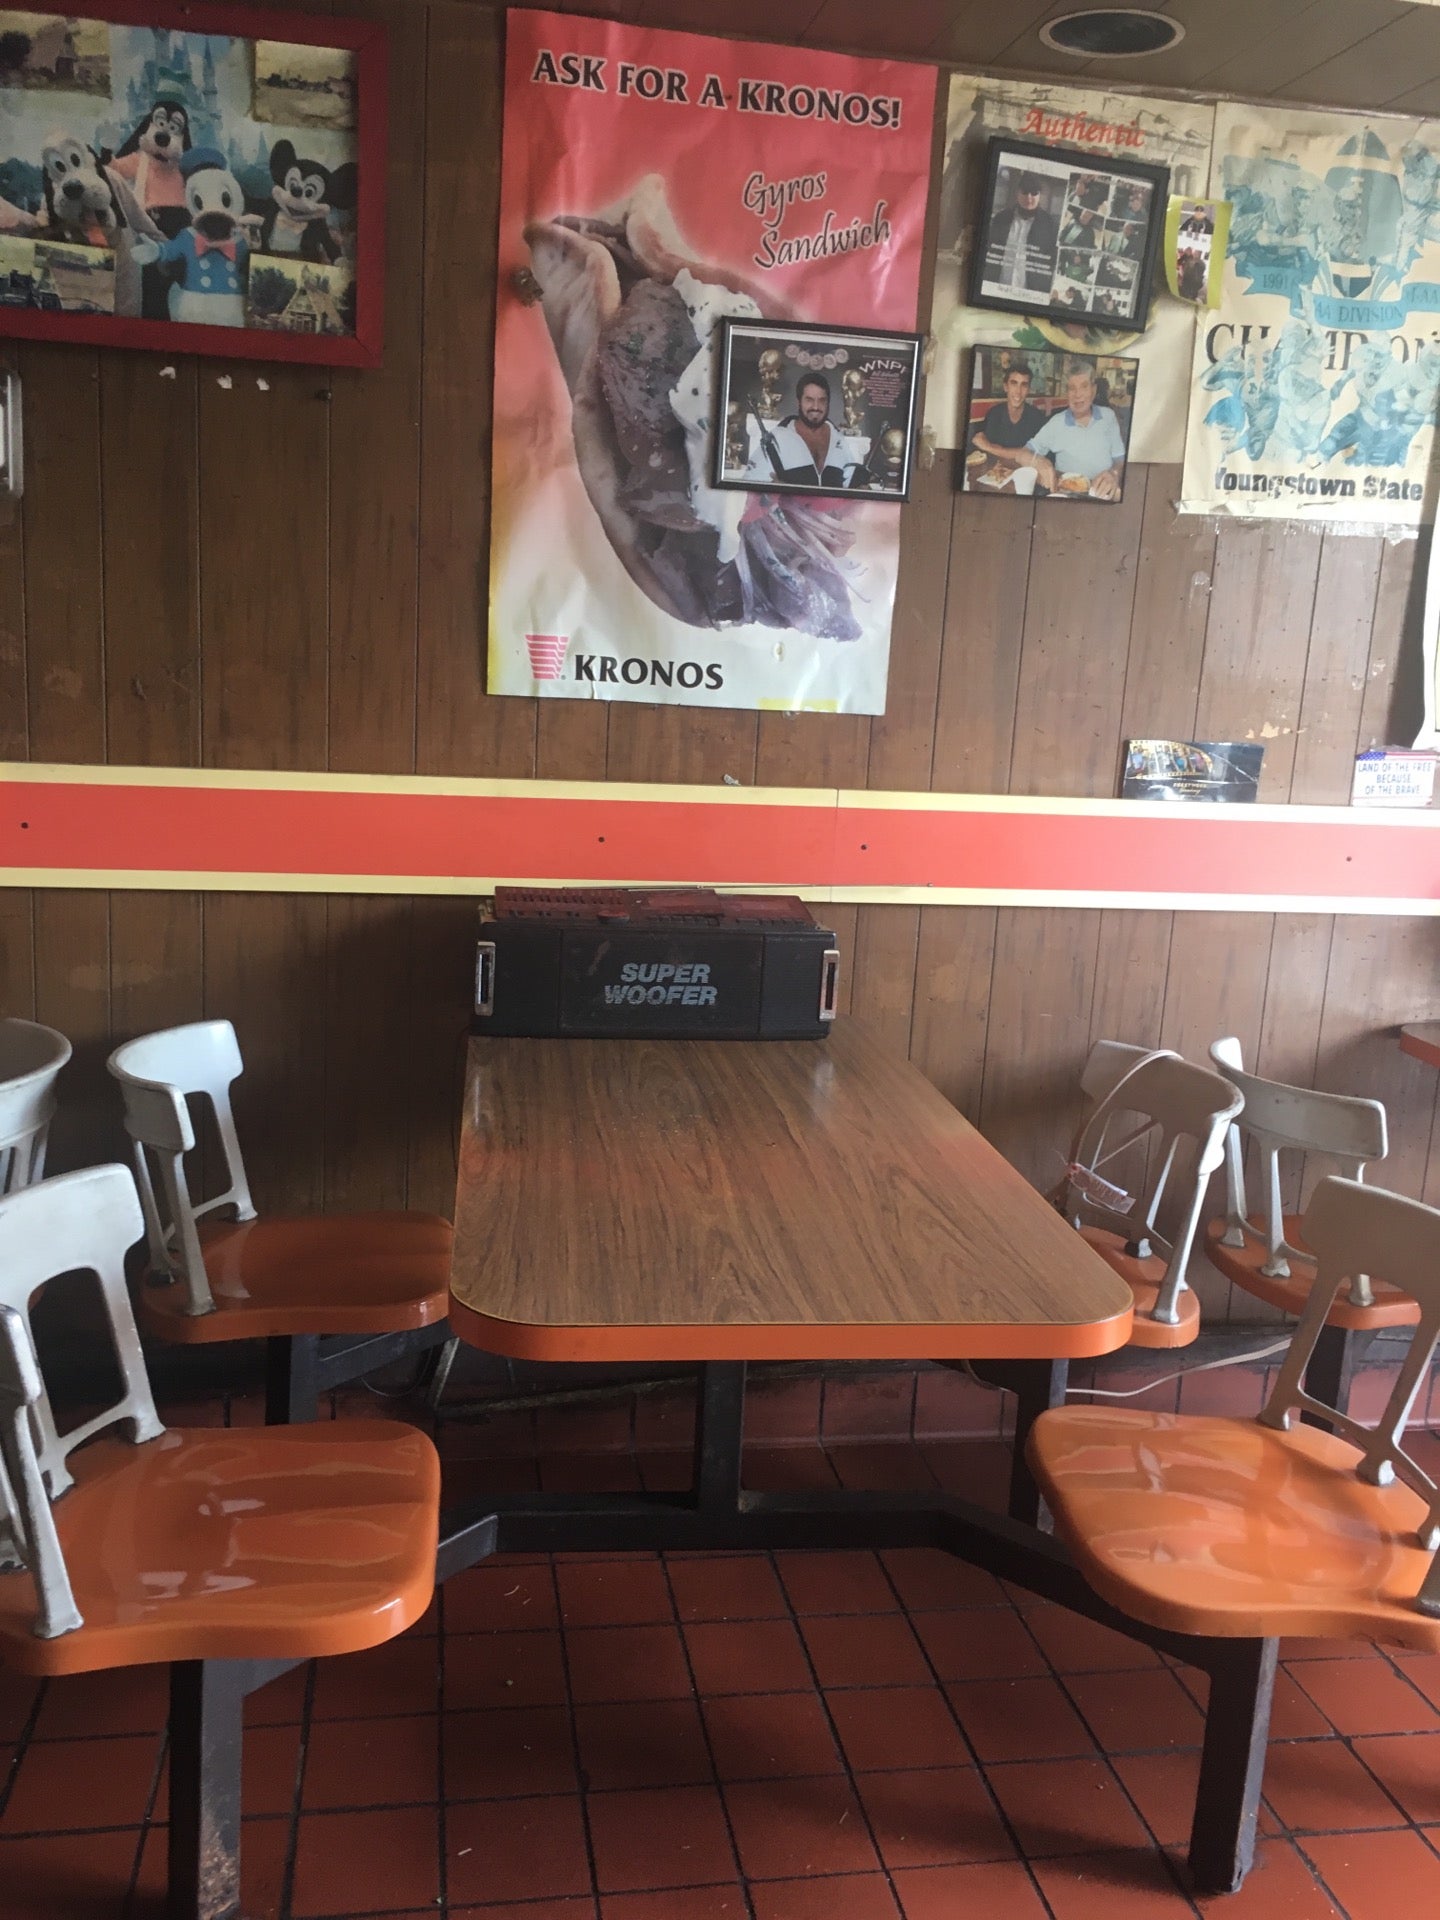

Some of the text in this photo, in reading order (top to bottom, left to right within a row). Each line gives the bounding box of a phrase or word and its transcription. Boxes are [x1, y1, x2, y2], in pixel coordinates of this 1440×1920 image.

[532, 51, 900, 128] ASK FOR A KRONOS!
[1020, 108, 1146, 148] Authentic
[743, 172, 826, 229] Gyros
[754, 202, 891, 270] Sandwich
[1262, 273, 1289, 290] 1991
[1337, 304, 1404, 323] DIVISION
[858, 359, 906, 375] WNPI
[1214, 467, 1424, 501] Youngstown State
[574, 653, 724, 690] KRONOS
[1358, 761, 1432, 773] LAND OF THE FREE
[1376, 773, 1412, 784] BECAUSE
[1364, 784, 1421, 795] OF THE BRAVE
[620, 963, 711, 984] SUPER
[603, 985, 718, 1006] WOOFER
